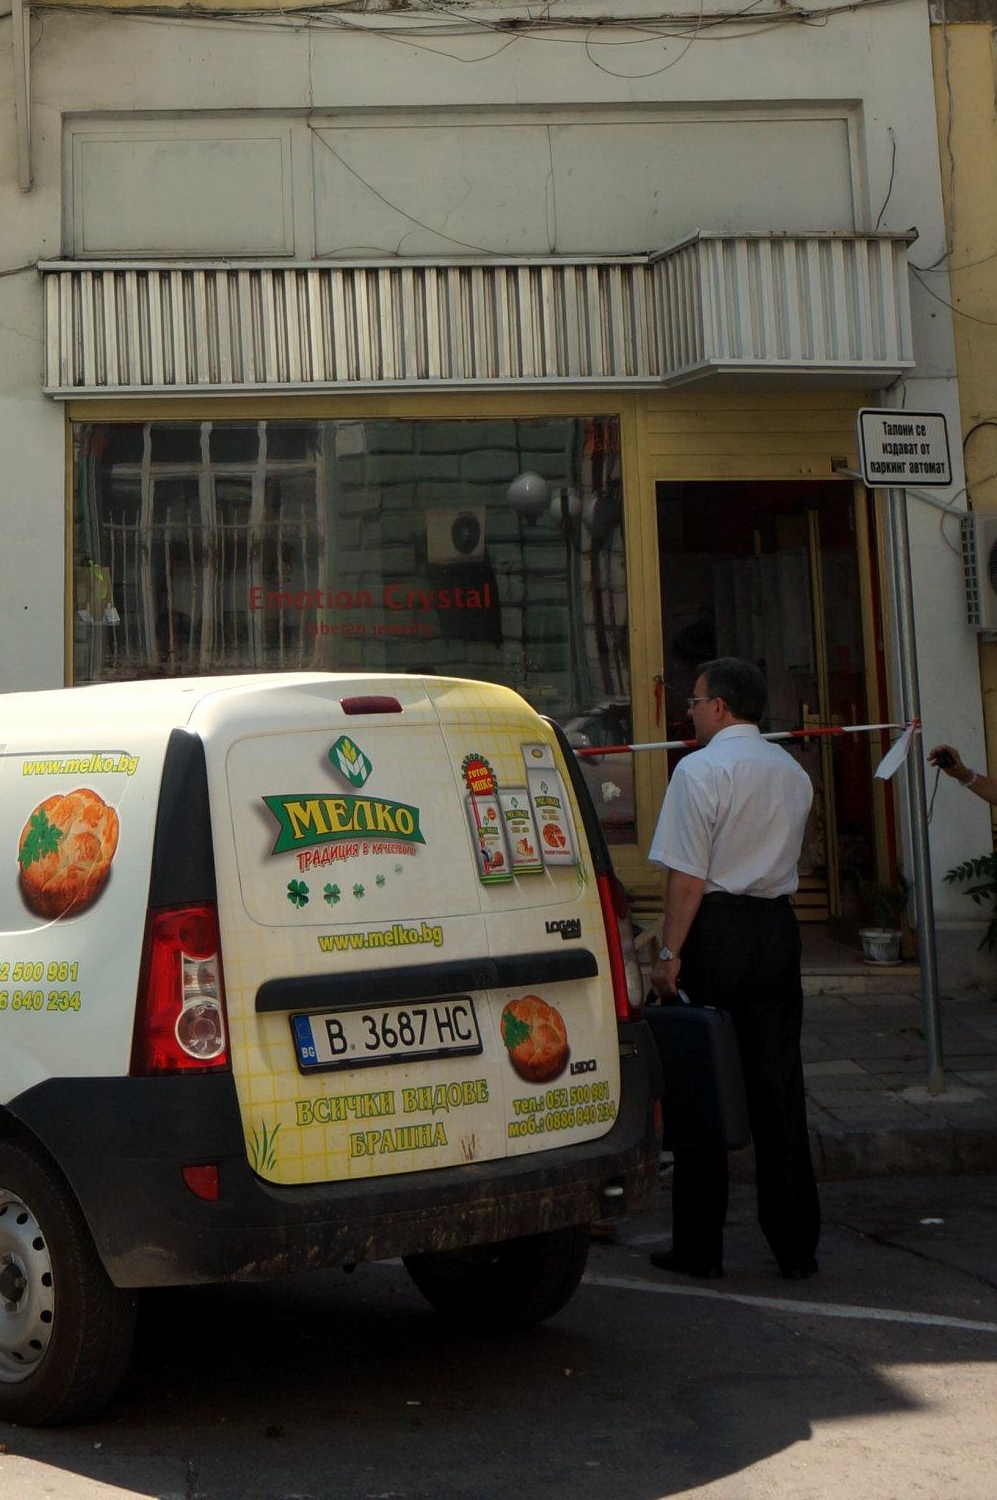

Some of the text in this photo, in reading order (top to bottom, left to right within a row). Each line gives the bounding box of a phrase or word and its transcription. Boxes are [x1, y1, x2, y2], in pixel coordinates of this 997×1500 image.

[882, 421, 926, 437] Талони се
[881, 442, 931, 457] издават от
[870, 461, 946, 475] паркинг автомат
[249, 581, 491, 613] Emotion Crystal
[22, 754, 141, 777] www.melko.bg
[468, 766, 489, 779] ГОТОВ
[282, 798, 415, 840] МЕЛКО
[296, 842, 359, 873] ТРАДИЦИЯ
[362, 842, 370, 856] В
[317, 922, 444, 952] www.melko.bg
[545, 918, 581, 934] LOGAN
[12, 962, 44, 982] 500
[46, 961, 79, 982] 981
[11, 989, 44, 1011] 840
[46, 990, 82, 1012] 234
[361, 1009, 428, 1051] 3687
[302, 1046, 316, 1059] BG
[295, 1078, 490, 1127] ВСИЧКИ ВИДОВЕ
[512, 1080, 610, 1116] тел.: 052 500 981
[507, 1100, 616, 1139] моб.: 0886 840 234
[349, 1122, 448, 1158] БРАШНА
